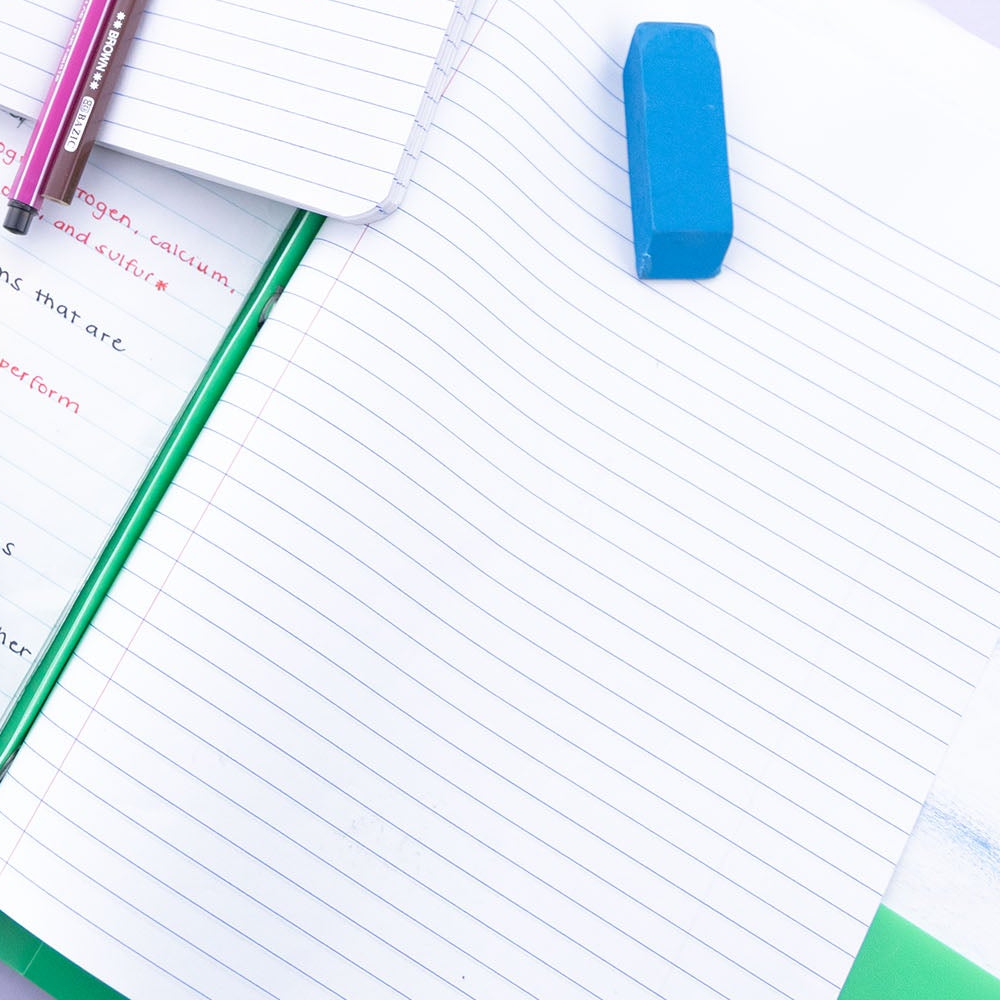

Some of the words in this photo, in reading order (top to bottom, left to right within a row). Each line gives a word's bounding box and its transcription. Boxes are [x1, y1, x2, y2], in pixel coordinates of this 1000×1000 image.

[95, 29, 120, 72] BROWN
[65, 112, 88, 151] BAZIC
[53, 219, 92, 245] and
[35, 288, 81, 324] that
[85, 323, 127, 353] are
